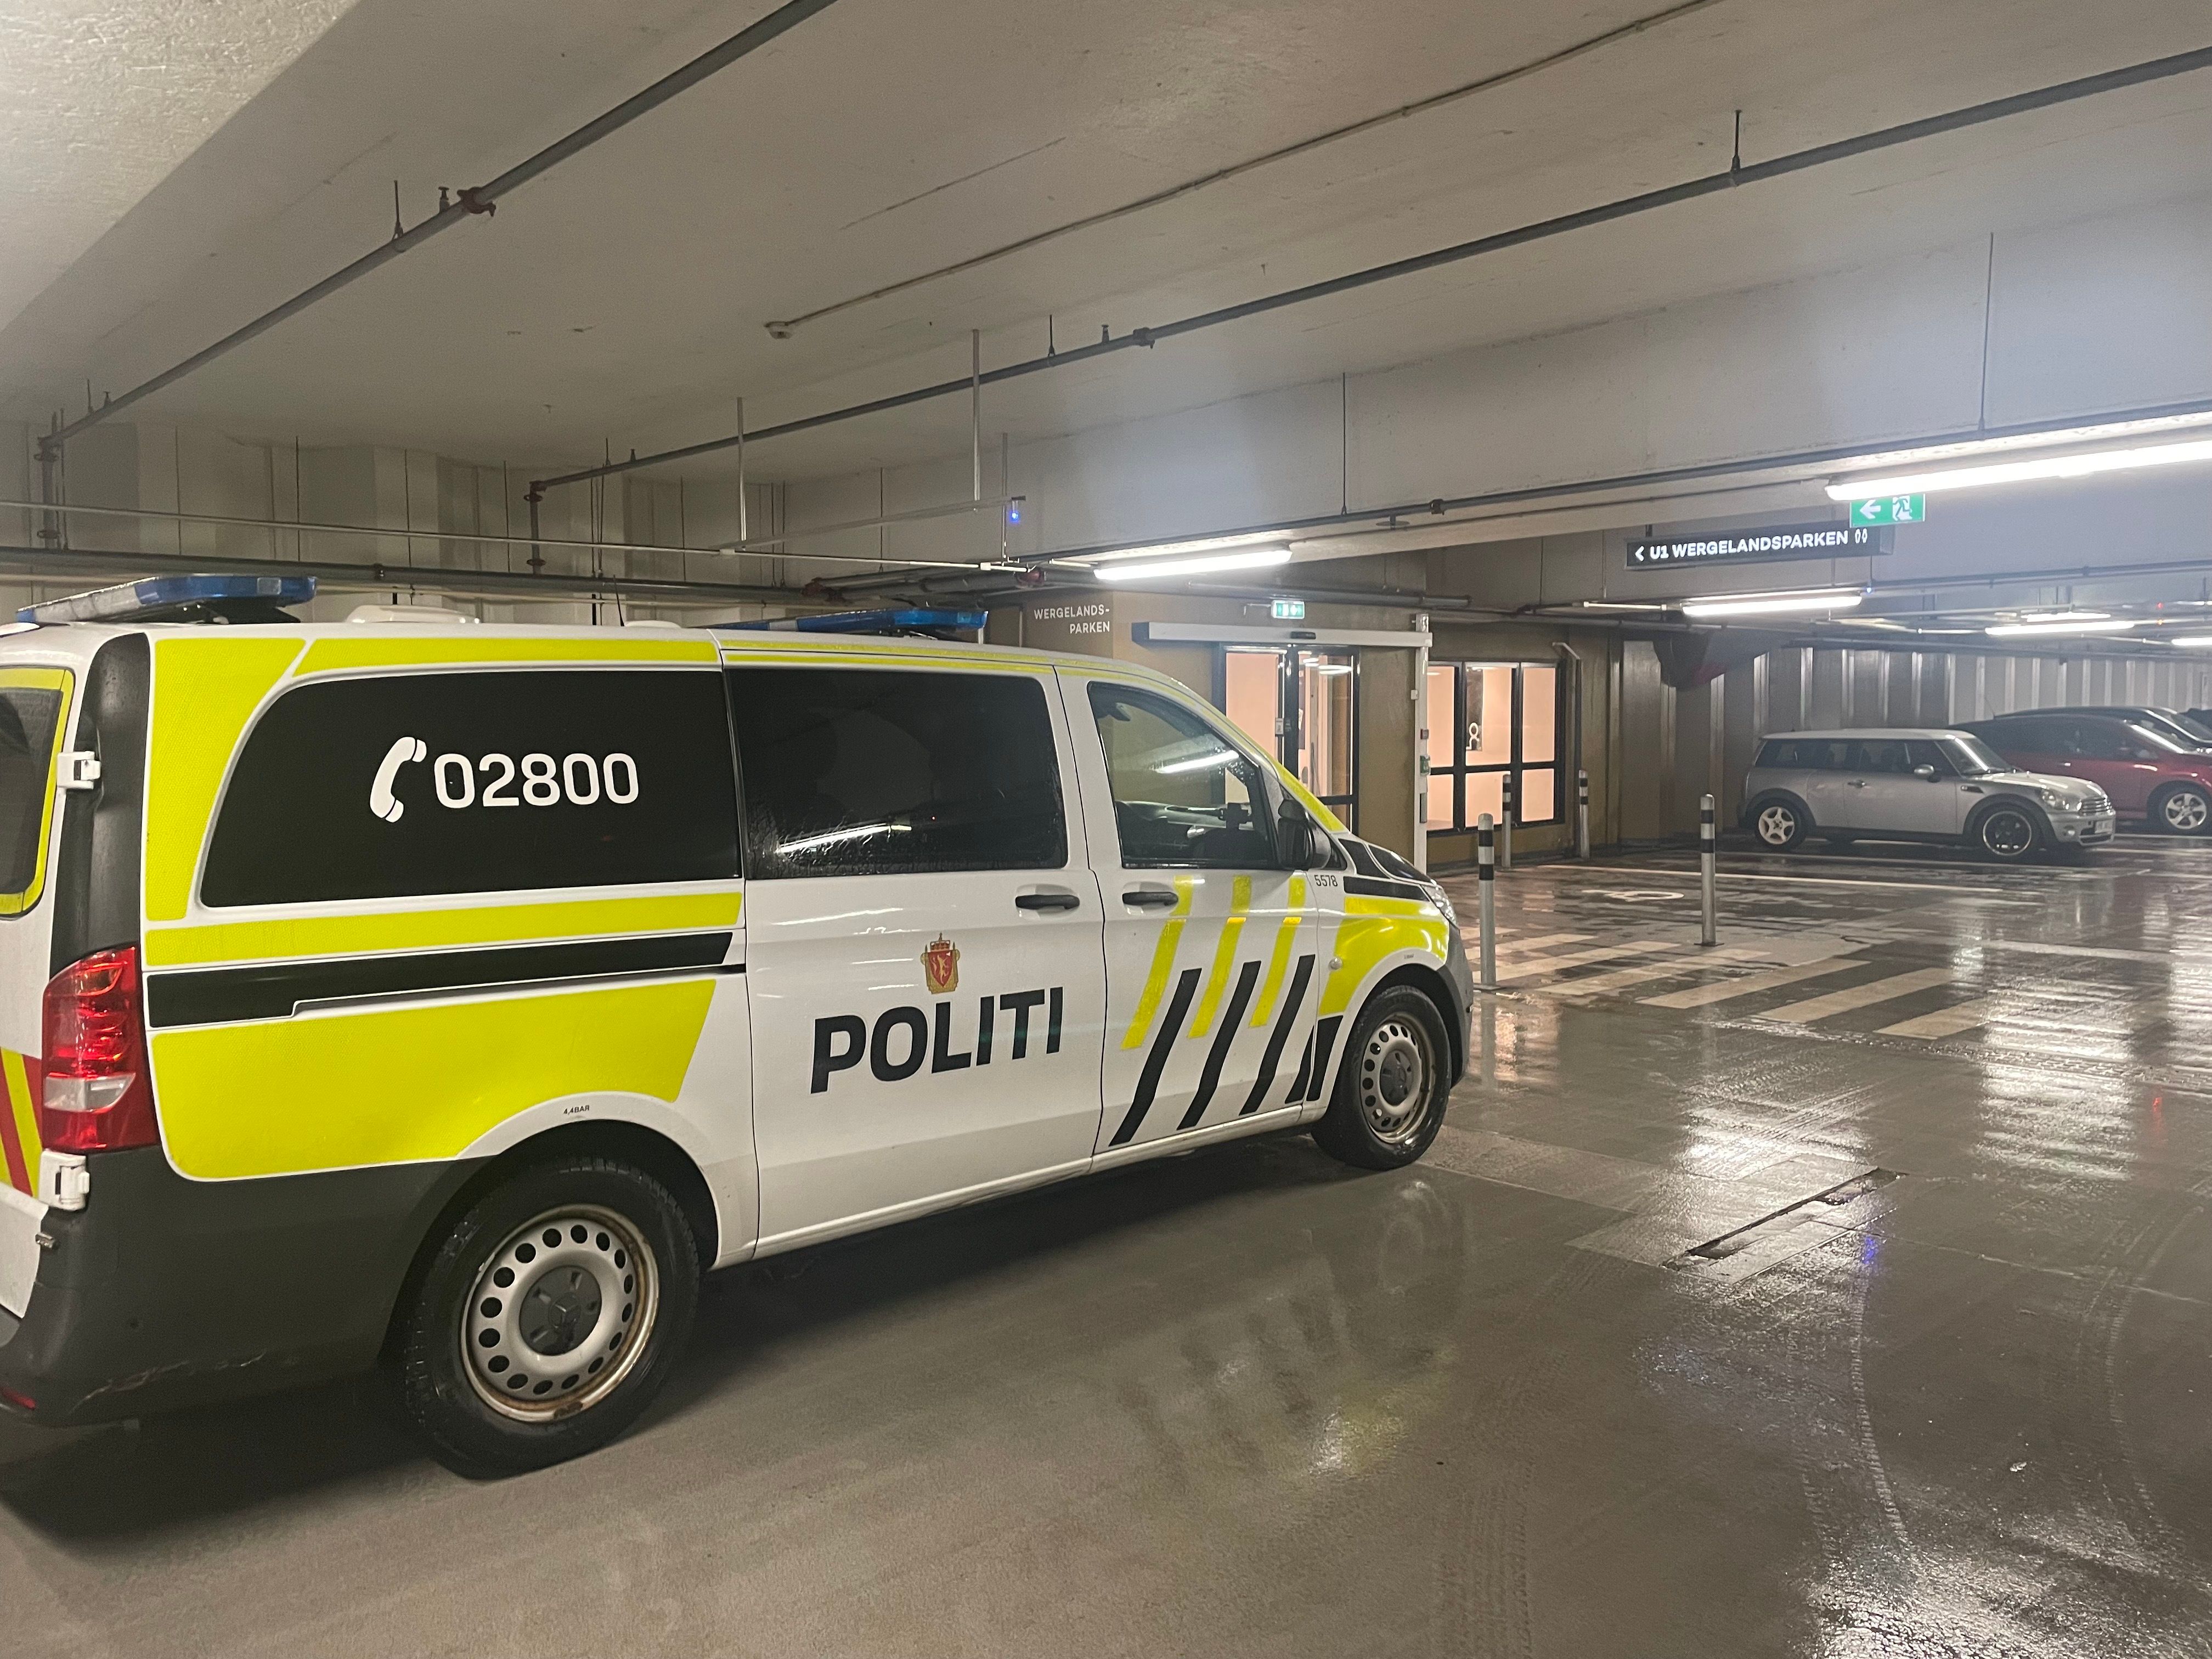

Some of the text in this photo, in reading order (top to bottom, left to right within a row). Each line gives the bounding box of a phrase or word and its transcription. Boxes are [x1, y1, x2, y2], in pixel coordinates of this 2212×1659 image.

[1649, 529, 1849, 560] U1 WERGELANDSPARKEN
[1034, 603, 1110, 620] WERGELANDS-
[1070, 620, 1110, 634] PARKEN
[433, 753, 639, 809] 02800
[1314, 874, 1338, 887] 5578
[810, 986, 1063, 1094] POLITI
